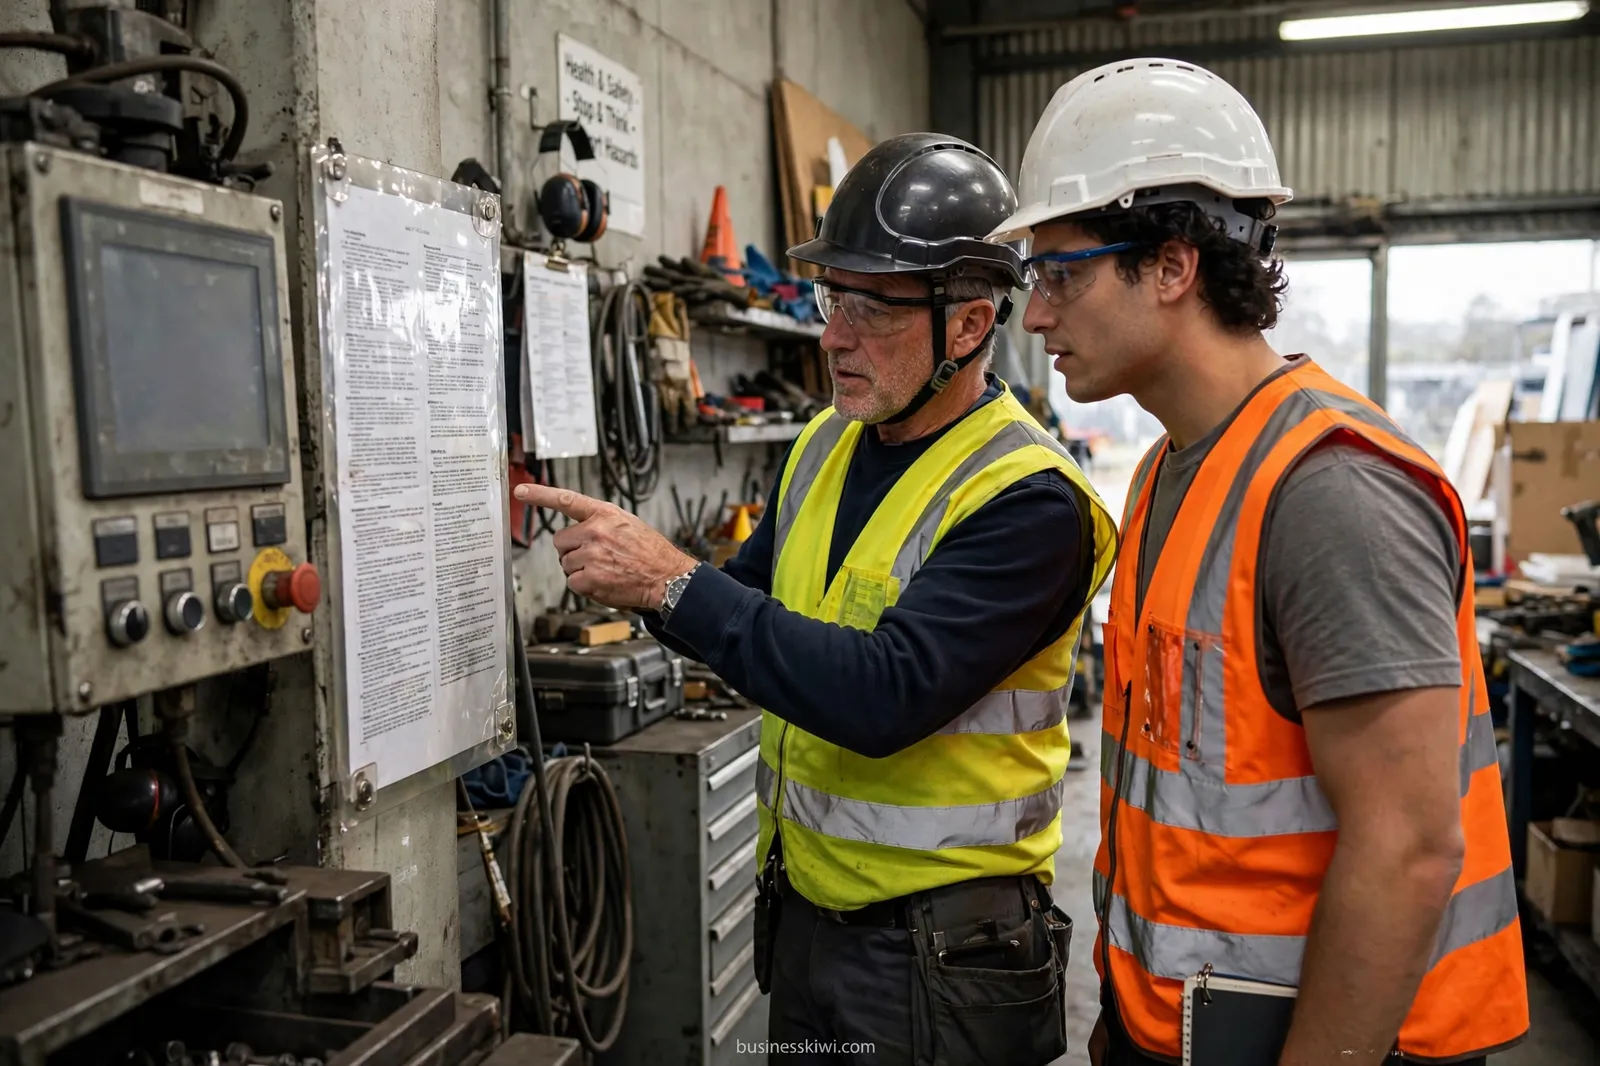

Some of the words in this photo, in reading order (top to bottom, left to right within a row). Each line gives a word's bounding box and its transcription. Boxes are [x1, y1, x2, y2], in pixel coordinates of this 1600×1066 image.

[564, 53, 595, 87] Health
[607, 74, 633, 111] Safety
[572, 90, 593, 124] Stop
[605, 105, 631, 135] Think
[605, 137, 638, 170] Hazards
